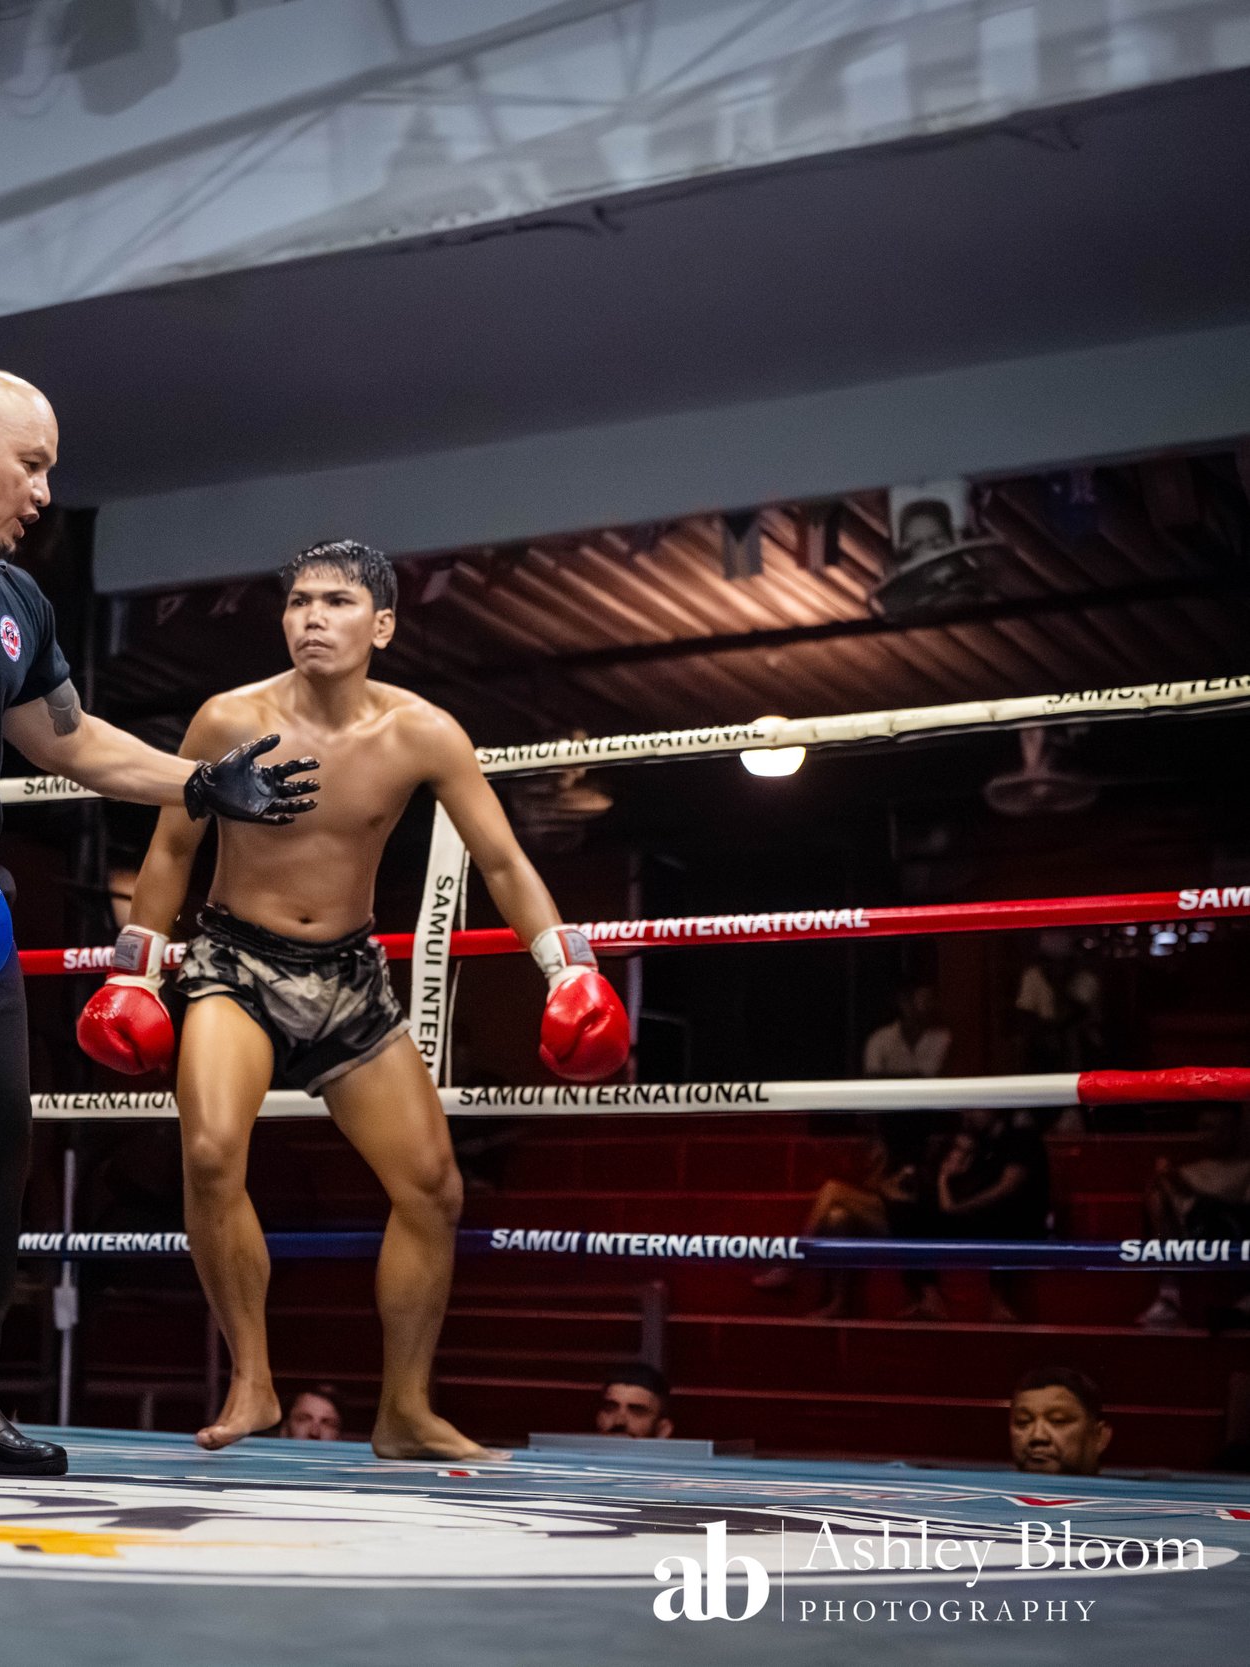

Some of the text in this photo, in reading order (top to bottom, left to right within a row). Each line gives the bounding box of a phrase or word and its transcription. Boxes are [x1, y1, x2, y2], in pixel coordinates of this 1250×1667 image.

[480, 742, 560, 765] SAMUI
[24, 776, 88, 795] SAMU
[578, 908, 870, 941] AMUI INTERNATIONAL
[63, 946, 115, 969] SAM
[418, 875, 454, 1073] SAMUI INTER
[459, 1084, 770, 1106] SAMUI INTERNATIONAL
[18, 1232, 63, 1251] MUI
[491, 1229, 805, 1259] SAMUI INTERNATIONAL
[1119, 1239, 1231, 1262] SAMUI
